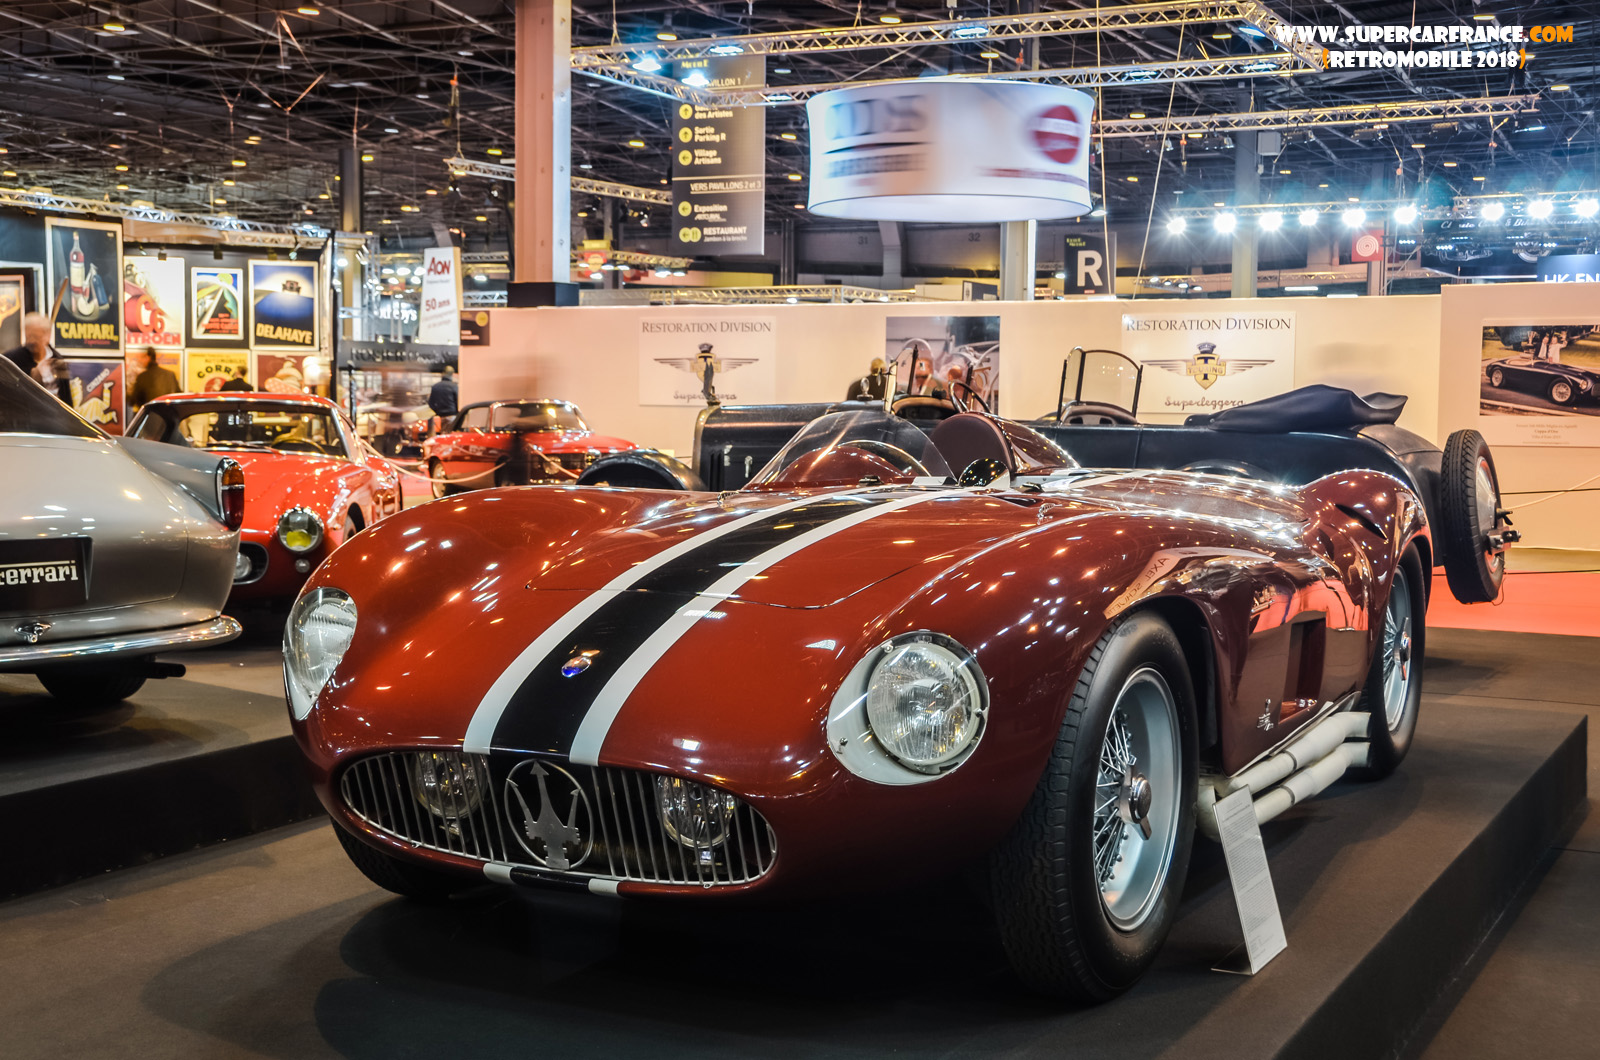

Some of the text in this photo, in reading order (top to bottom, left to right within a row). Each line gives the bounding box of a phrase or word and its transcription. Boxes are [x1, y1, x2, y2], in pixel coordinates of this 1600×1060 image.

[702, 77, 736, 87] AVILLON
[707, 110, 733, 118] Artistes
[694, 126, 715, 134] Sortie
[694, 132, 727, 143] Parking R
[694, 149, 717, 158] Village
[694, 157, 722, 165] Artisans
[690, 182, 708, 191] VERS
[708, 181, 744, 190] PAVILLONS
[693, 204, 728, 213] Exposition
[703, 226, 747, 235] RESTAURANT
[858, 235, 869, 245] 31
[968, 232, 981, 242] 32
[1077, 250, 1103, 287] R
[425, 298, 437, 312] 50
[642, 321, 772, 333] RESTORATION DIVISION
[1126, 317, 1292, 331] RESTORATION DIVISION
[256, 322, 313, 344] DELAHAYE
[126, 331, 182, 346] ITROEN
